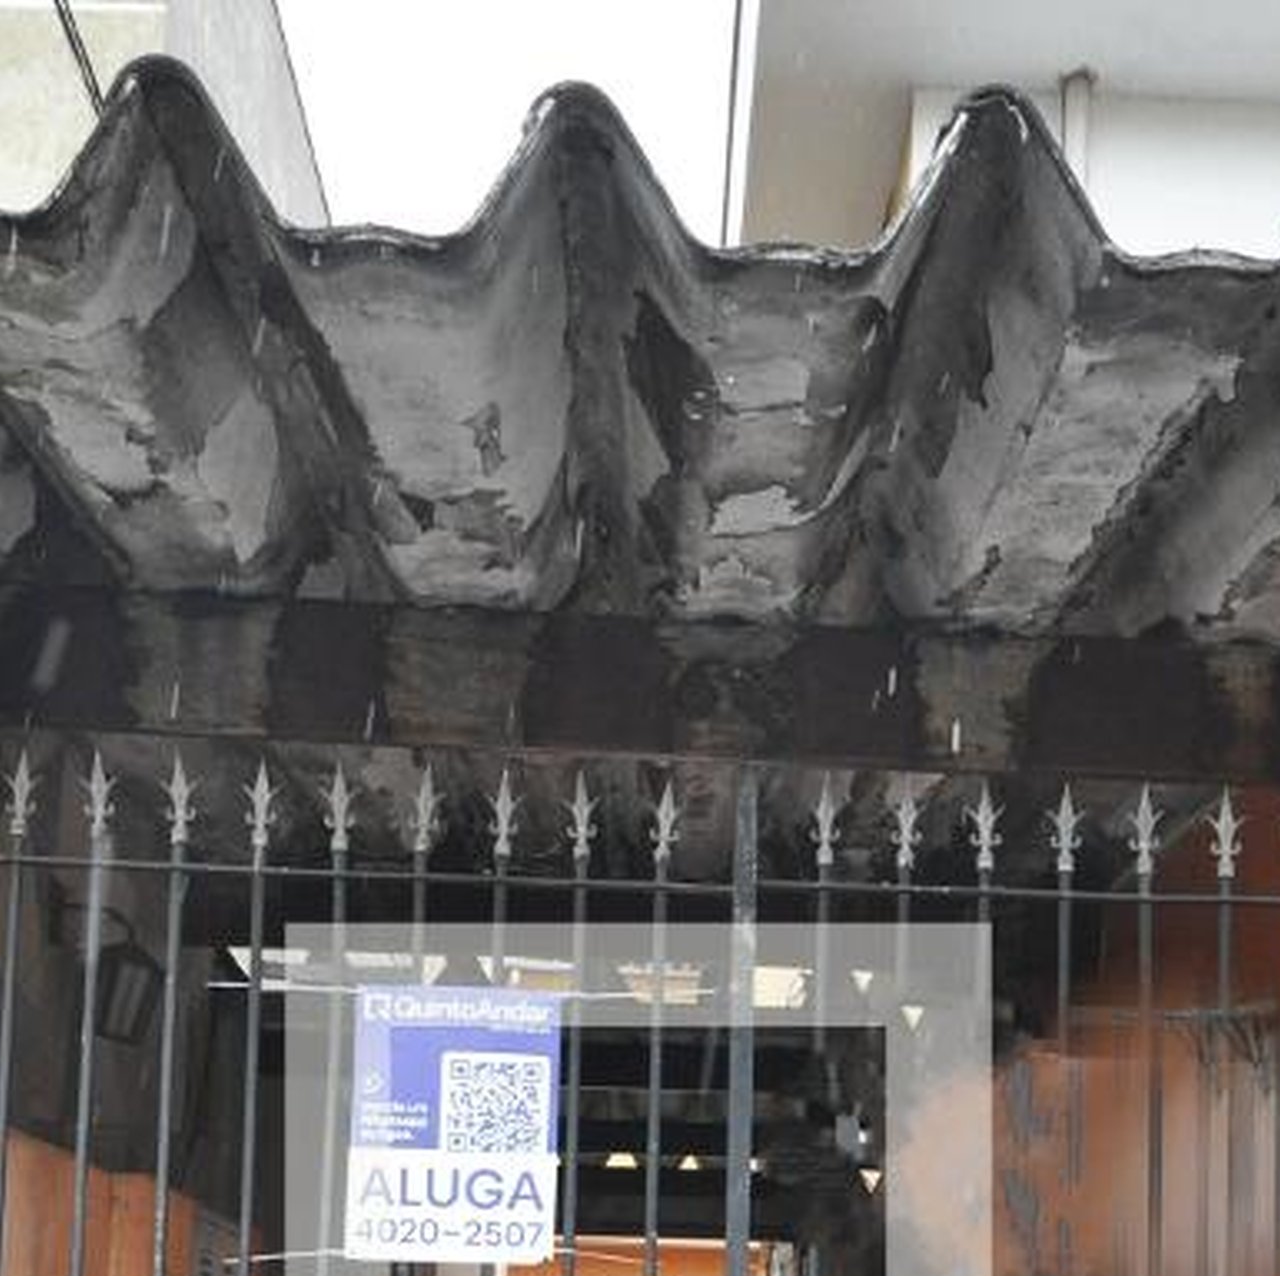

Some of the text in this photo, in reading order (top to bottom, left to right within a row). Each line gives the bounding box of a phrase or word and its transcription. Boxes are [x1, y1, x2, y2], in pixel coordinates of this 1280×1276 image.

[394, 994, 554, 1022] QuintoAndar
[359, 1167, 544, 1211] ALUGA
[353, 1217, 545, 1248] 4020-2507
